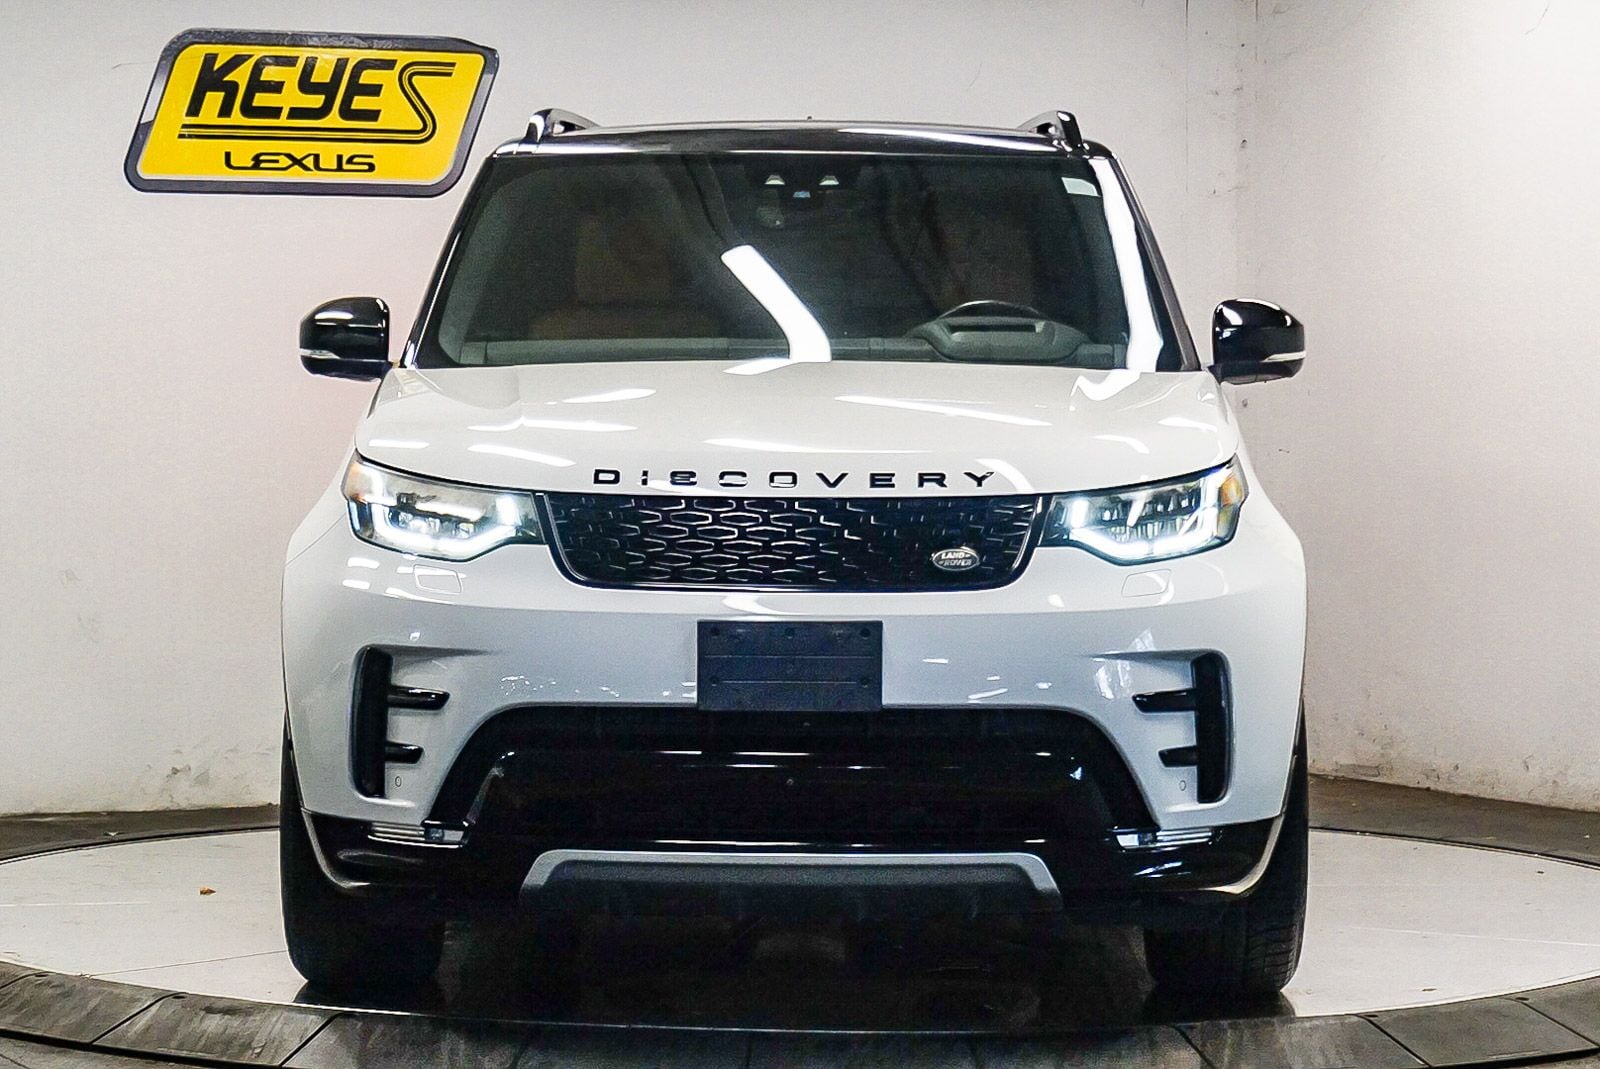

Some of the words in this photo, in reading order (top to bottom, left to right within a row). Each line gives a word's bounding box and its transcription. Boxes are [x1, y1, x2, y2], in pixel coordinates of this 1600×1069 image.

[179, 53, 457, 144] KEYES
[224, 150, 376, 173] LEXUS
[592, 468, 995, 489] DISCOVERY
[941, 551, 965, 560] LAND
